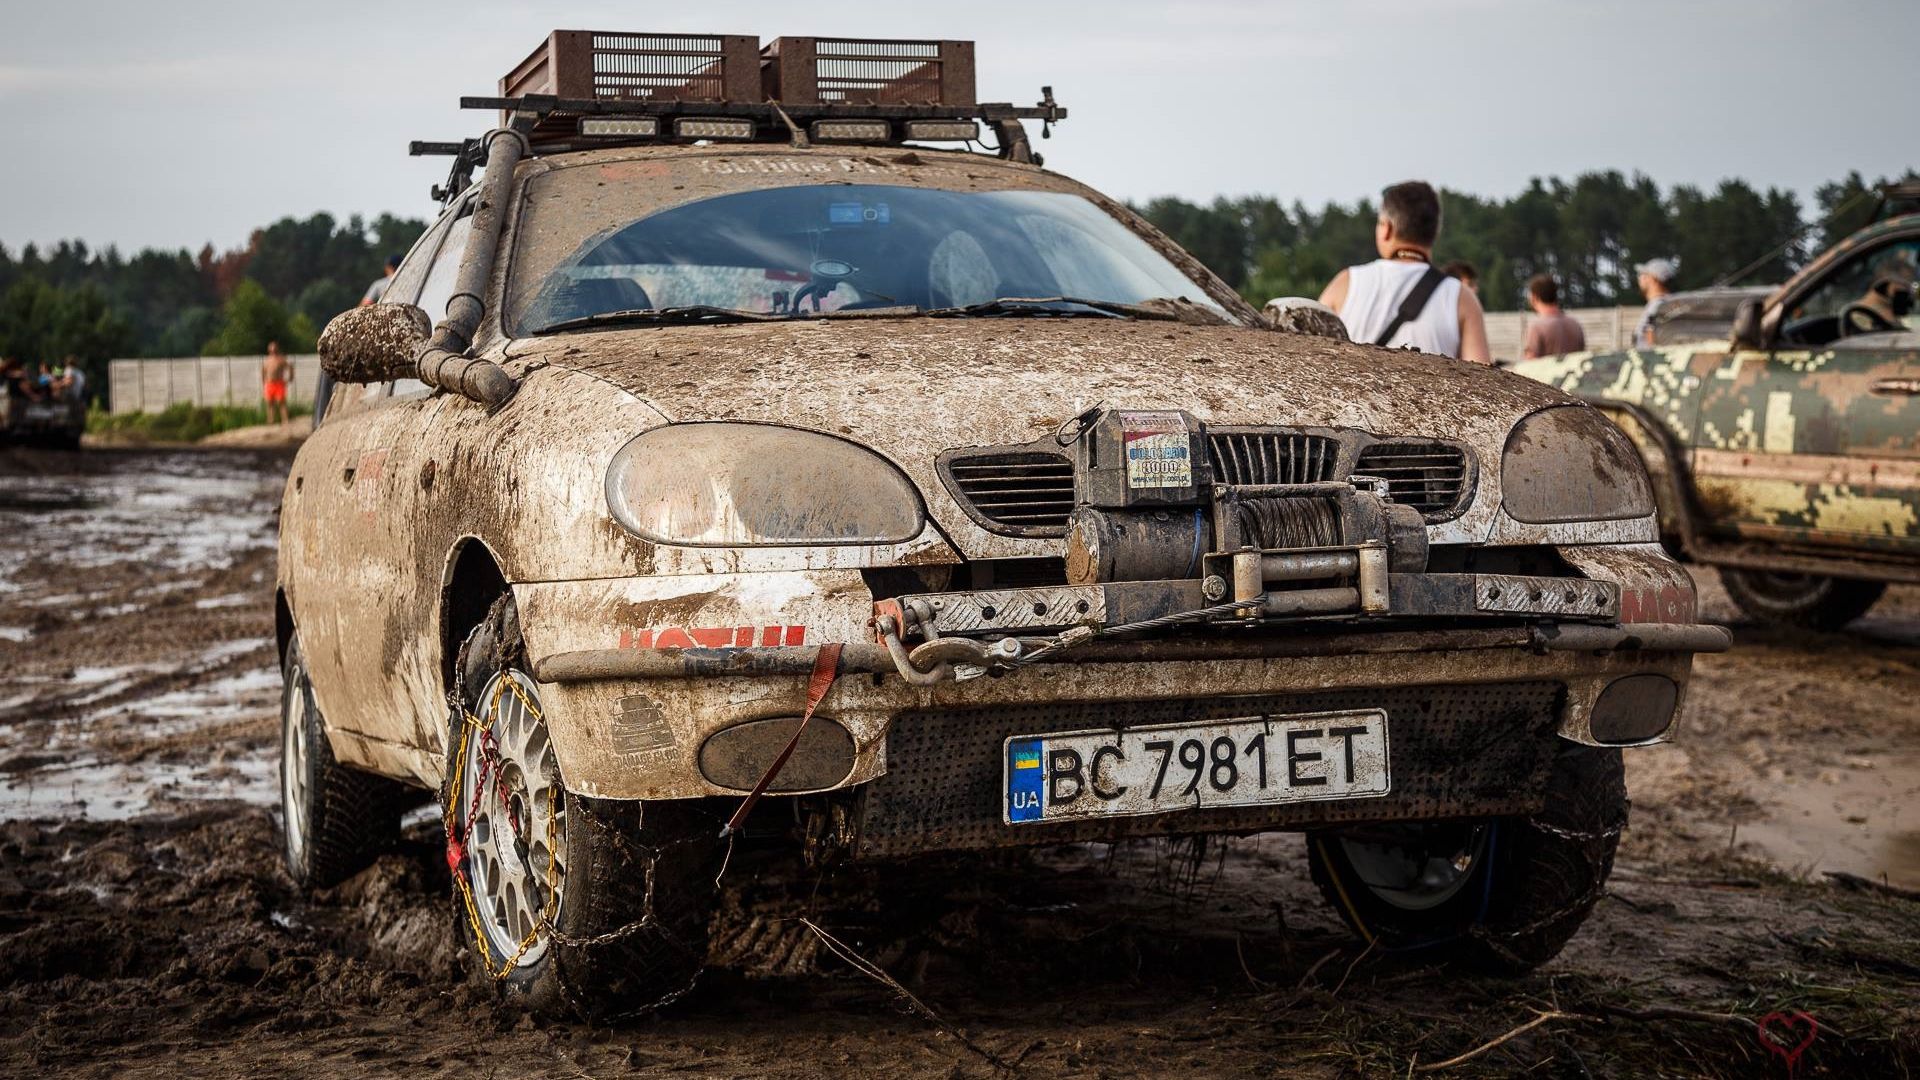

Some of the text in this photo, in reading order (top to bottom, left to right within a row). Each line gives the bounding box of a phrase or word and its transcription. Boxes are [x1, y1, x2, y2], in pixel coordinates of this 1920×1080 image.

[1049, 725, 1369, 808] BC 7981 ET
[1013, 791, 1040, 810] UA
